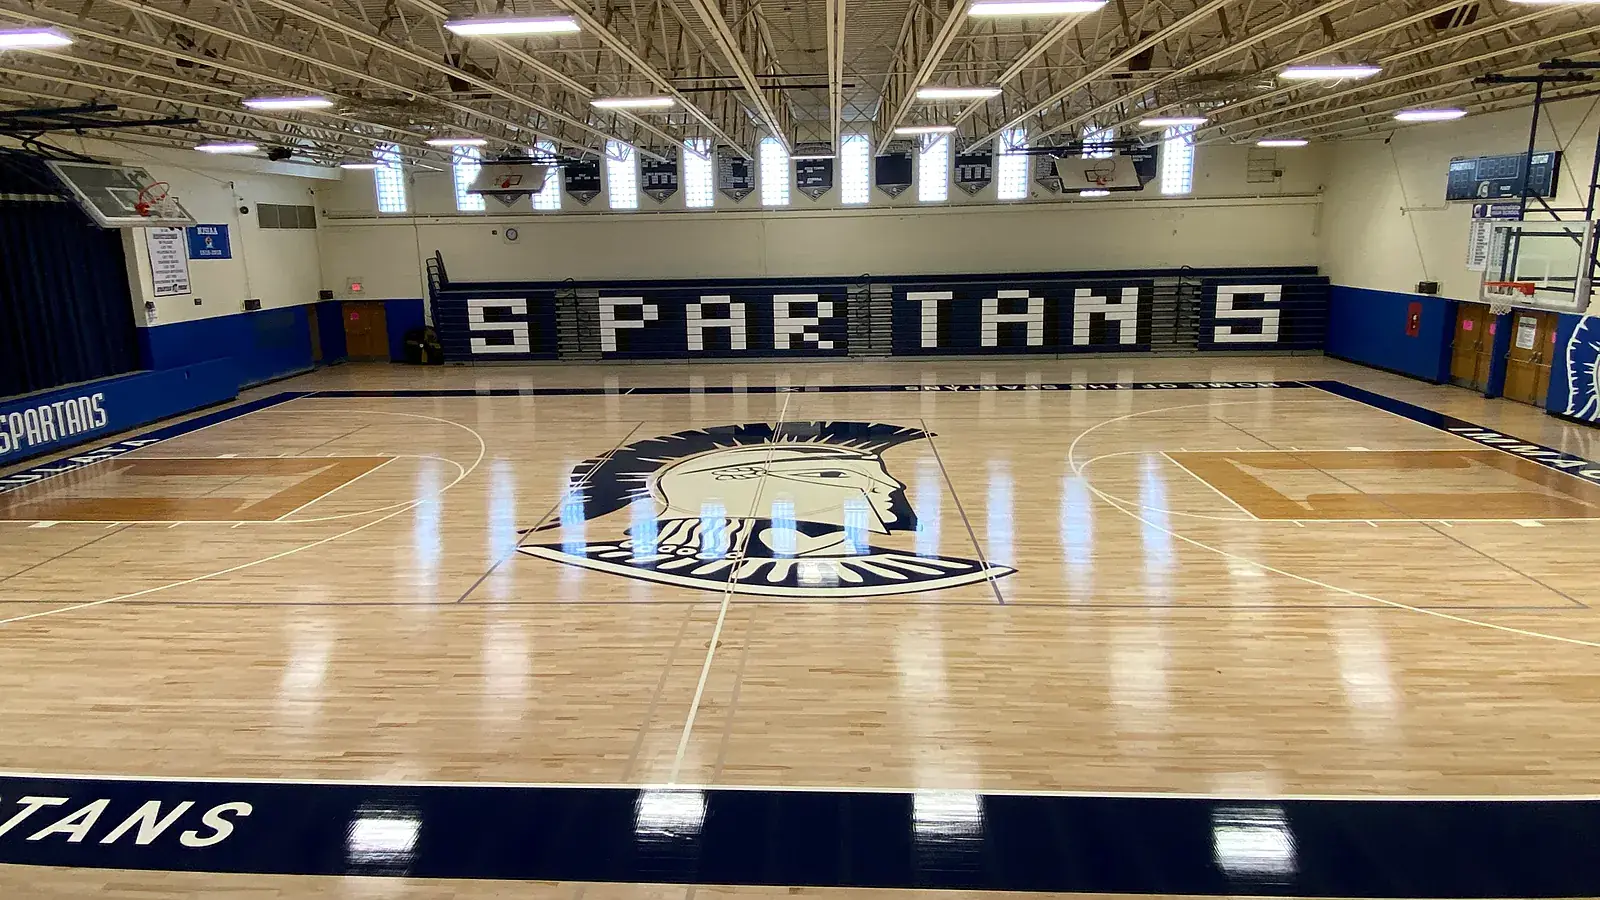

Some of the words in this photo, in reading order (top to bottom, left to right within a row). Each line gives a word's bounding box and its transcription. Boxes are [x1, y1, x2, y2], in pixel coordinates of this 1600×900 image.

[467, 284, 1282, 354] SPARTANS
[0, 393, 107, 453] SPARTANS
[0, 438, 160, 490] ULATA
